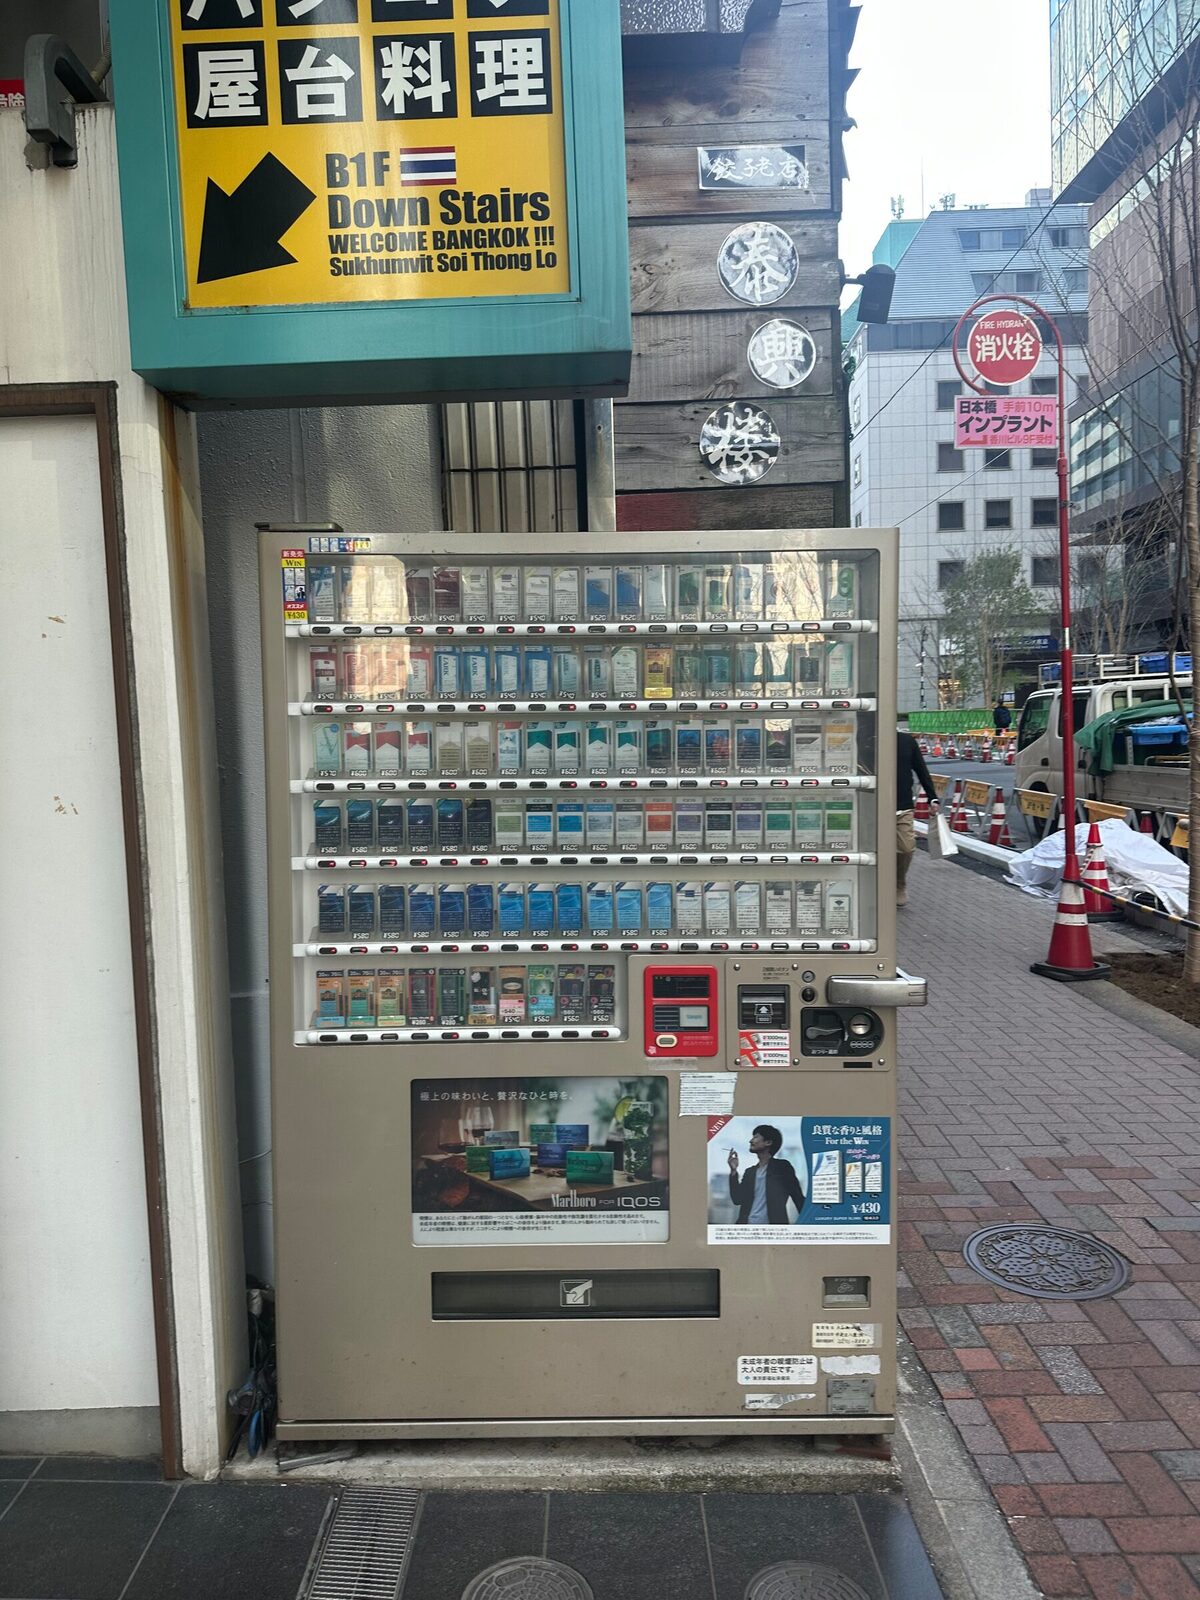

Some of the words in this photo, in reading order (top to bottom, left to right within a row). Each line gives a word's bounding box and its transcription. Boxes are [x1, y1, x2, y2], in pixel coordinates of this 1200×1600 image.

[194, 37, 547, 120] 屋台料理
[325, 150, 390, 188] B1F
[327, 194, 430, 229] Down
[438, 187, 551, 226] Stairs
[328, 231, 429, 254] WELCOME
[432, 227, 529, 250] BANGKOK
[330, 254, 434, 277] Sukhumvit
[438, 252, 468, 272] Soi
[471, 250, 532, 272] Thong
[536, 249, 558, 269] Lo
[980, 319, 996, 329] FIRE
[975, 333, 1035, 362] 消火栓
[959, 401, 997, 414] 日本橋
[1003, 401, 1054, 413] 手前10m
[959, 415, 1053, 433] インプラント
[419, 1090, 574, 1102] 極上の味わいと、贅沢なひと時を。
[708, 1117, 726, 1136] NEW
[811, 1124, 883, 1136] 良質な香りと風格
[551, 1189, 597, 1208] Marlboro
[616, 1196, 661, 1209] IQOS
[851, 1202, 881, 1214] ¥430
